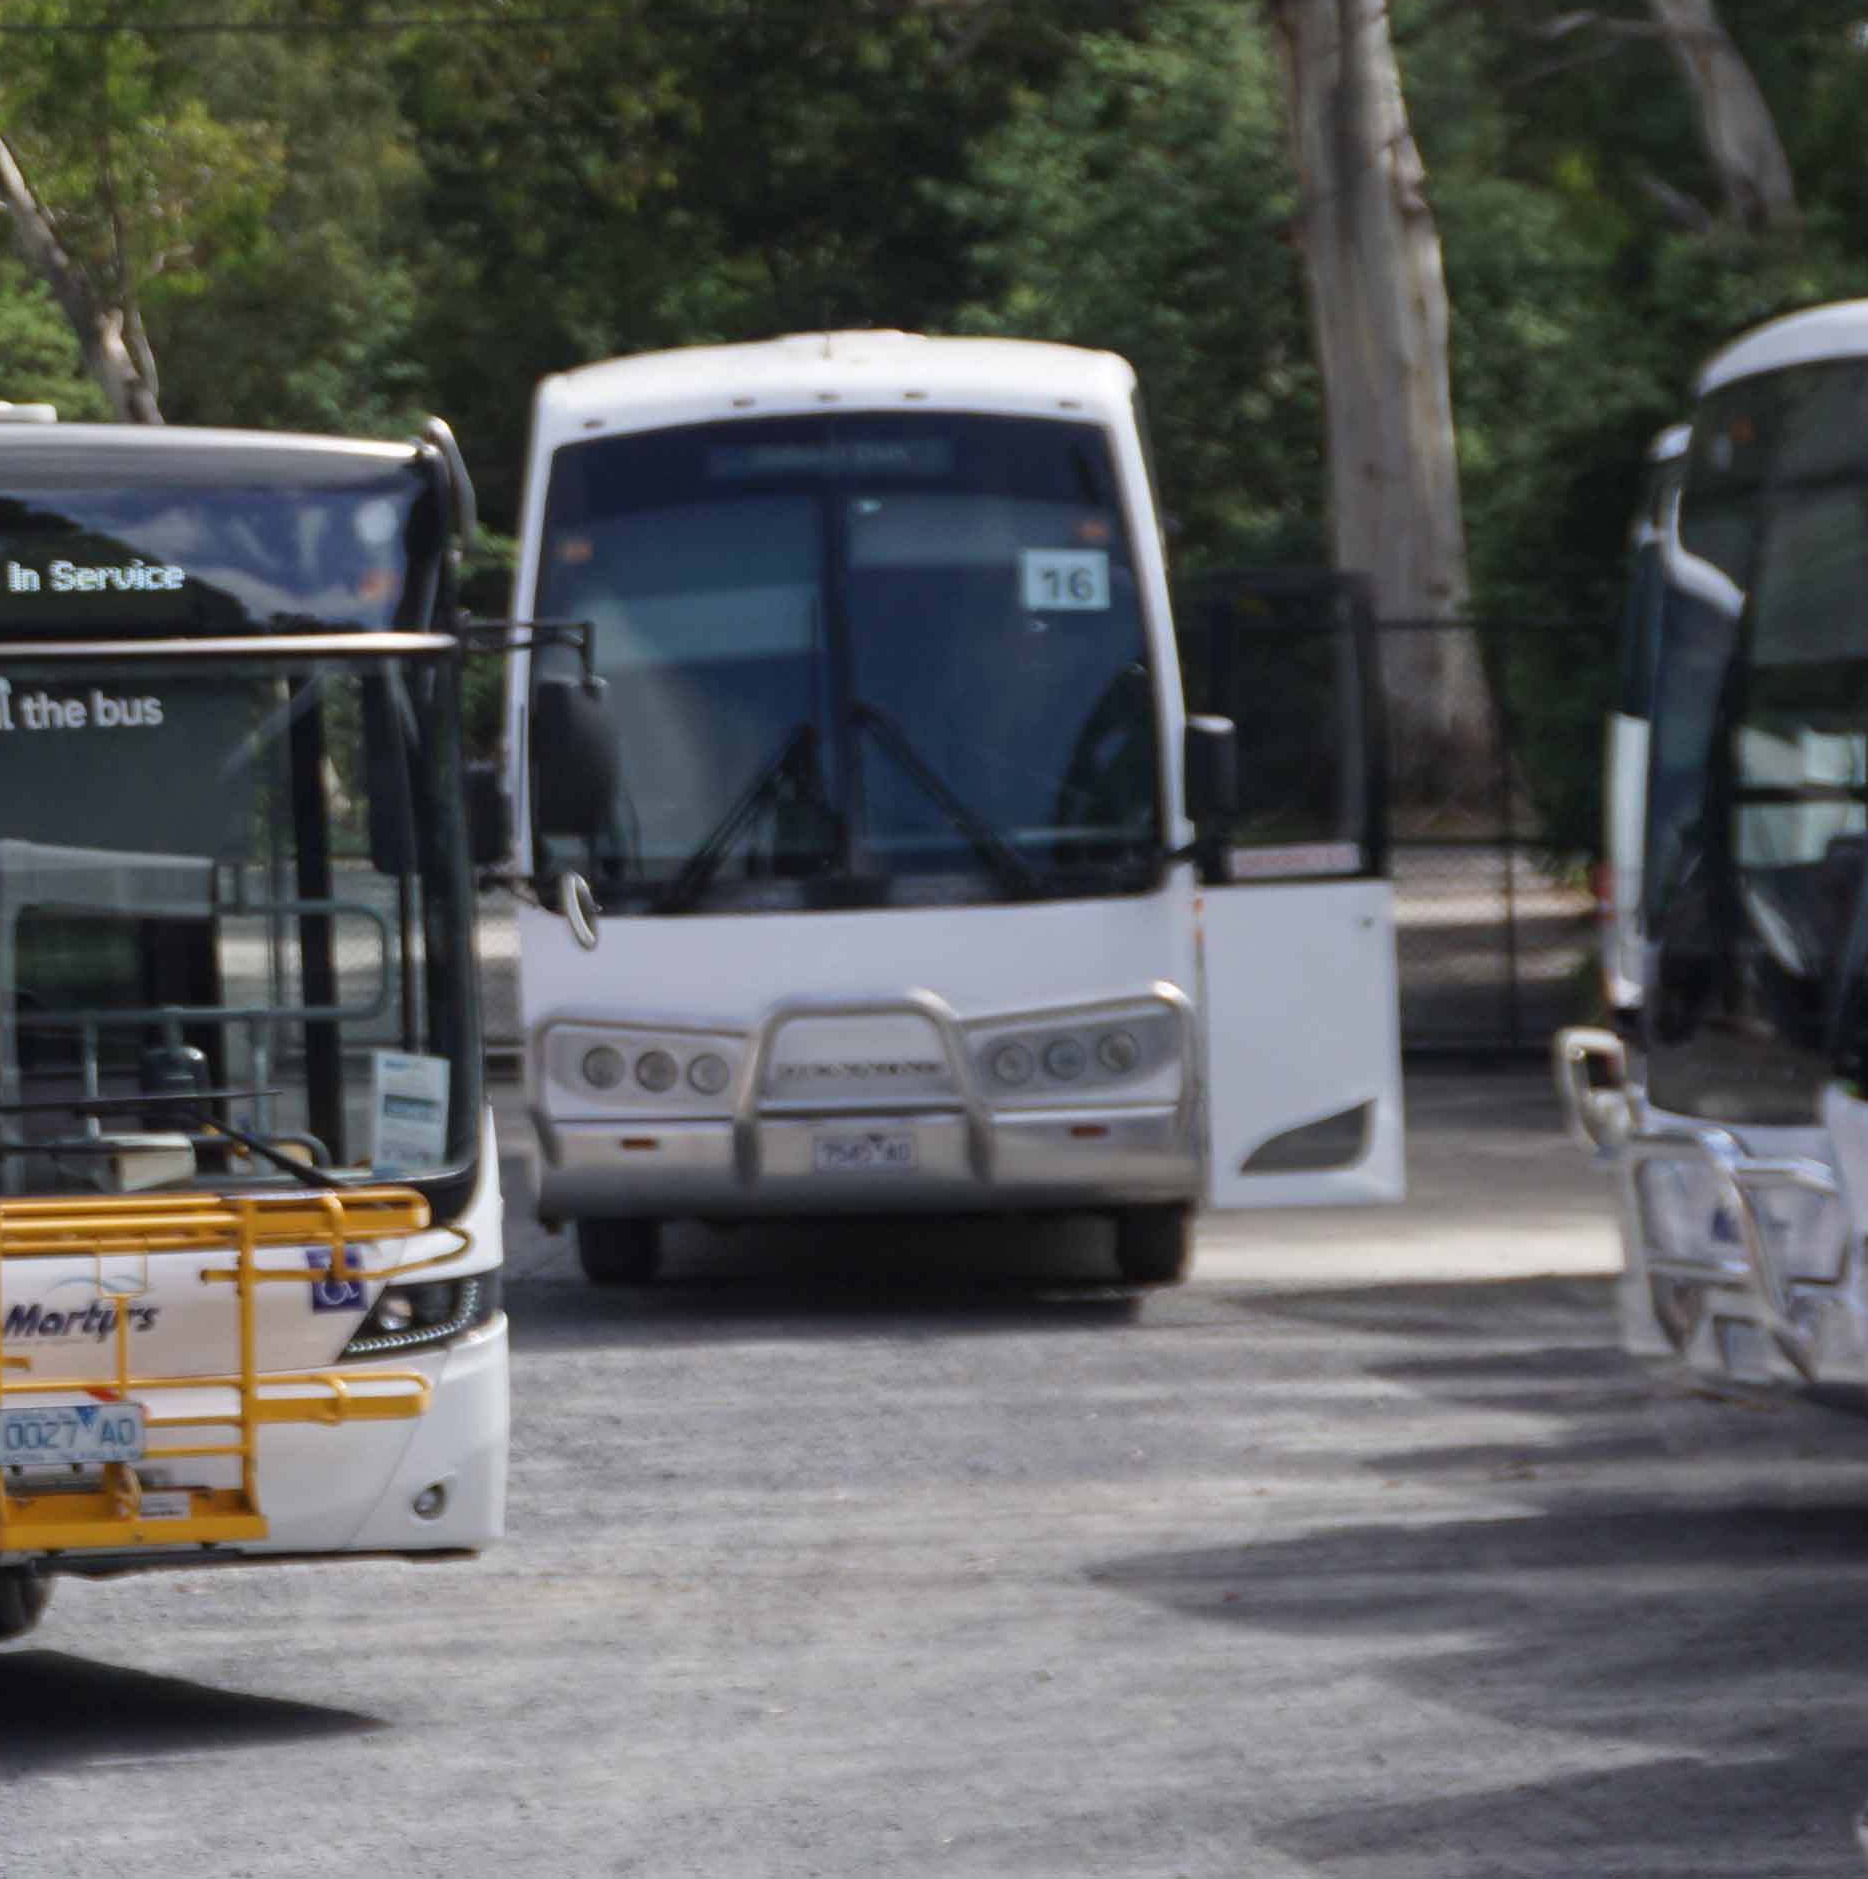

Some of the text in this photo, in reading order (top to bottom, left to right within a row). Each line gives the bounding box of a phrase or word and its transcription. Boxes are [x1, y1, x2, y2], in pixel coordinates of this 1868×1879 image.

[8, 561, 41, 593] In
[50, 558, 185, 593] Service
[1041, 566, 1096, 600] 16
[19, 690, 88, 730] the
[90, 687, 164, 728] bus
[2, 1300, 159, 1344] Martyrs
[7, 1420, 77, 1450] 0027
